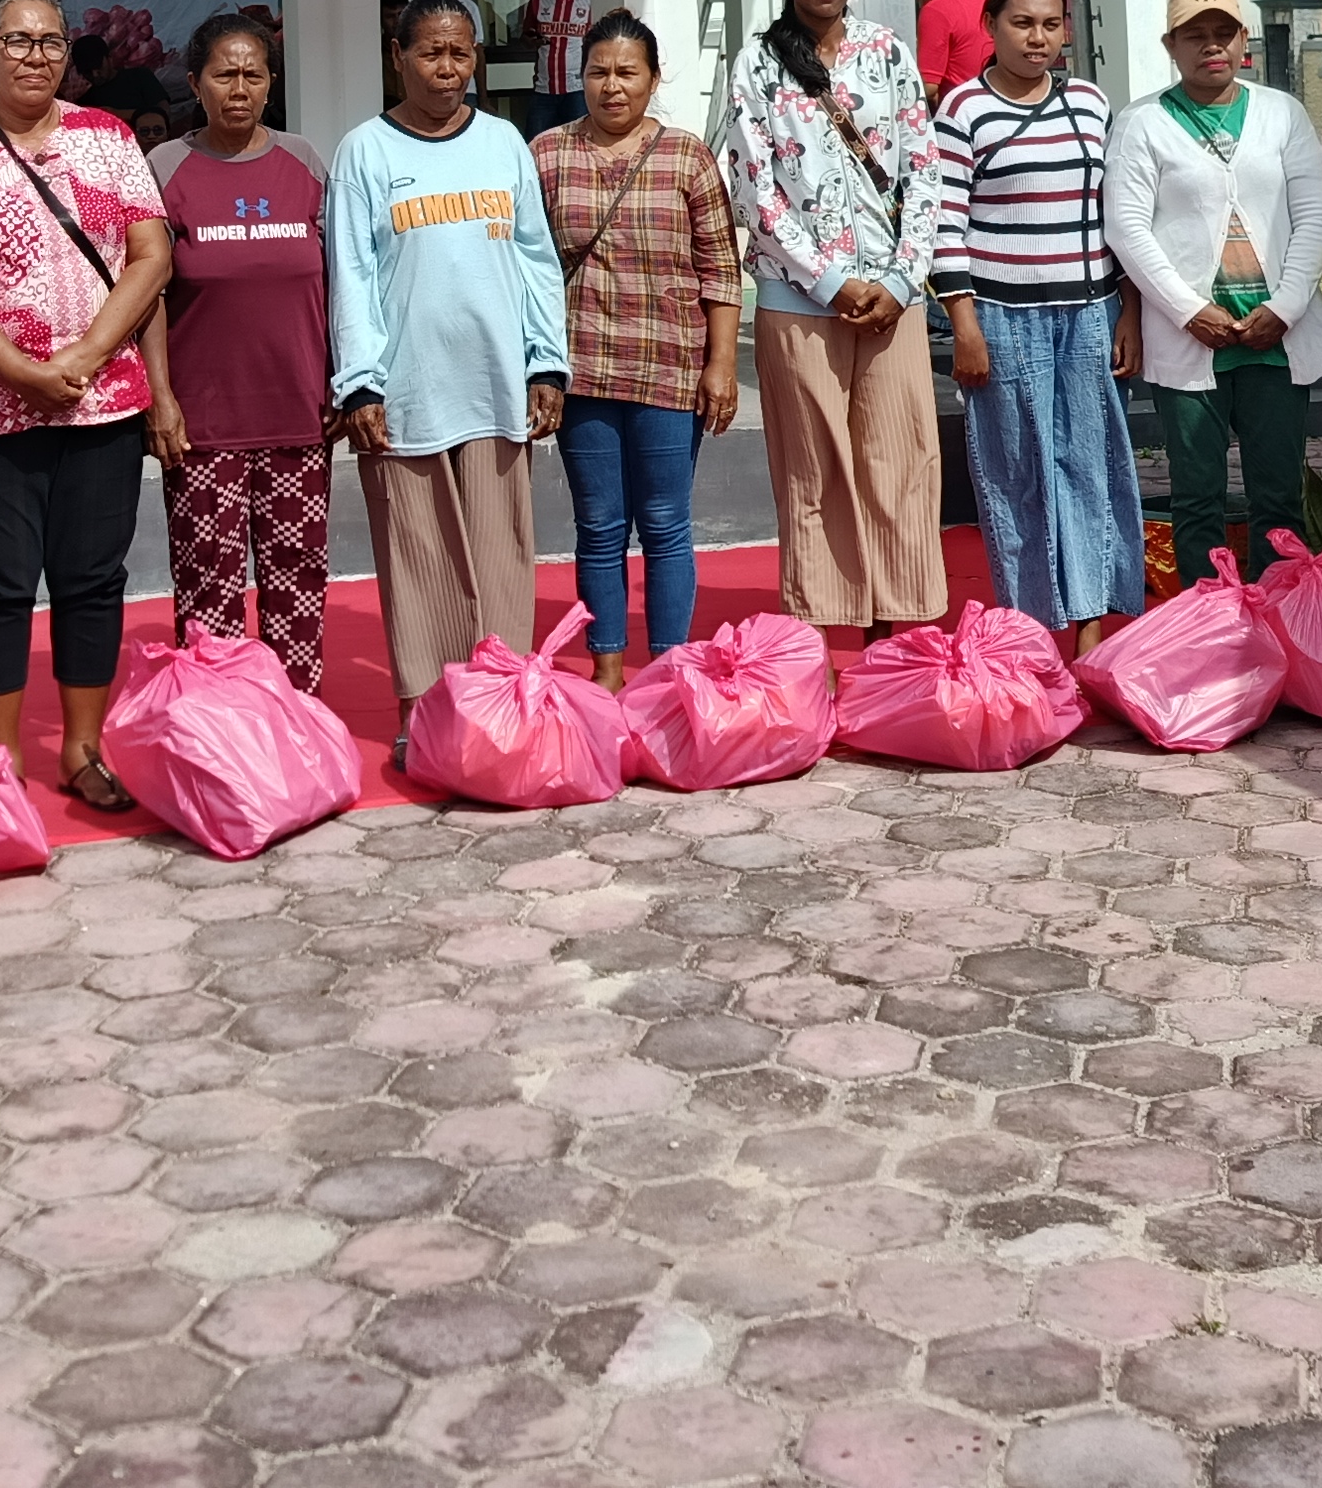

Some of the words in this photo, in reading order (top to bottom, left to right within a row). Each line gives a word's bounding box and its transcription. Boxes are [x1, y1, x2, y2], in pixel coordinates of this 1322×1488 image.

[389, 189, 513, 235] DEMOLISH
[197, 224, 247, 243] UNDER
[249, 221, 308, 241] ARMOUR
